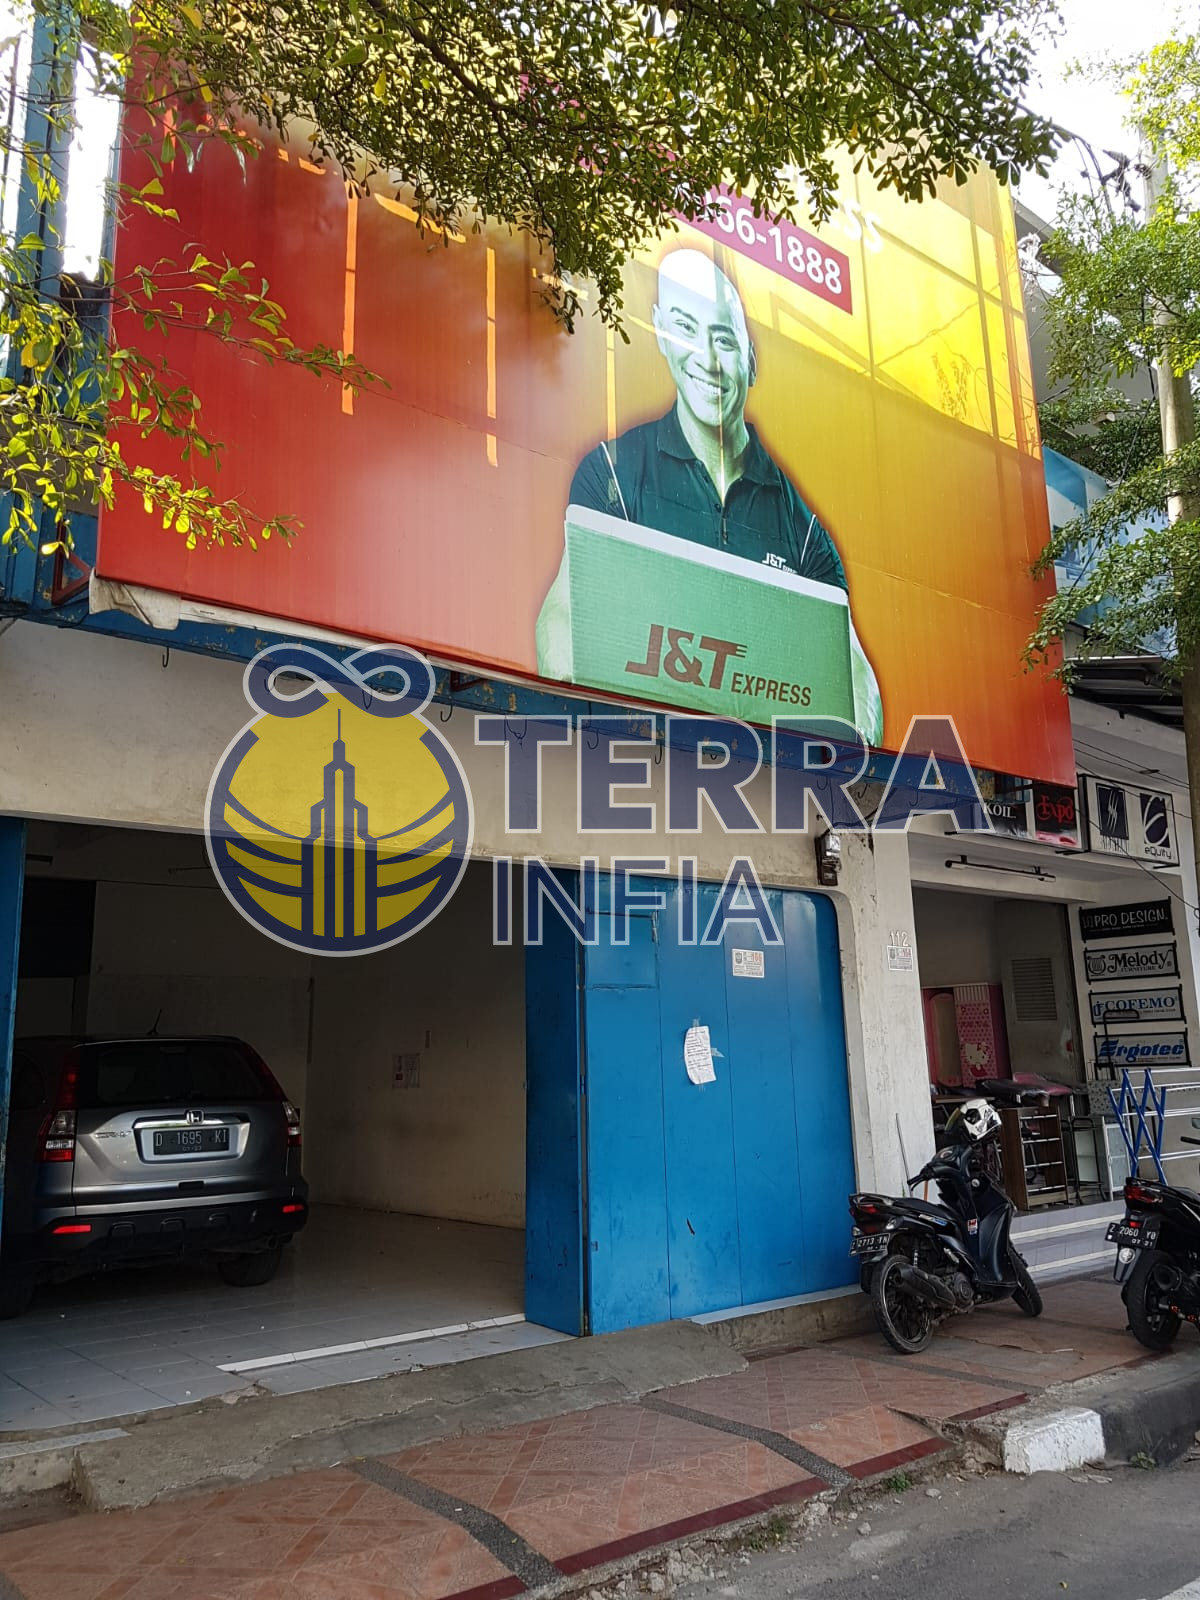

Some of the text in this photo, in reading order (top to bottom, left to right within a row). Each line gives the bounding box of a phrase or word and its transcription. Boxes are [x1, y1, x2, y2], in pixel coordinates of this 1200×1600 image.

[762, 552, 786, 569] J&T
[625, 623, 812, 707] J&T EXPRESS
[889, 930, 910, 947] 112
[1107, 948, 1174, 973] Melody
[1105, 996, 1175, 1010] COFEMO
[1099, 1040, 1185, 1063] Ergotec
[155, 1132, 163, 1147] D
[176, 1130, 202, 1146] 1695
[1109, 1224, 1116, 1233] Z
[1119, 1226, 1139, 1237] 2060
